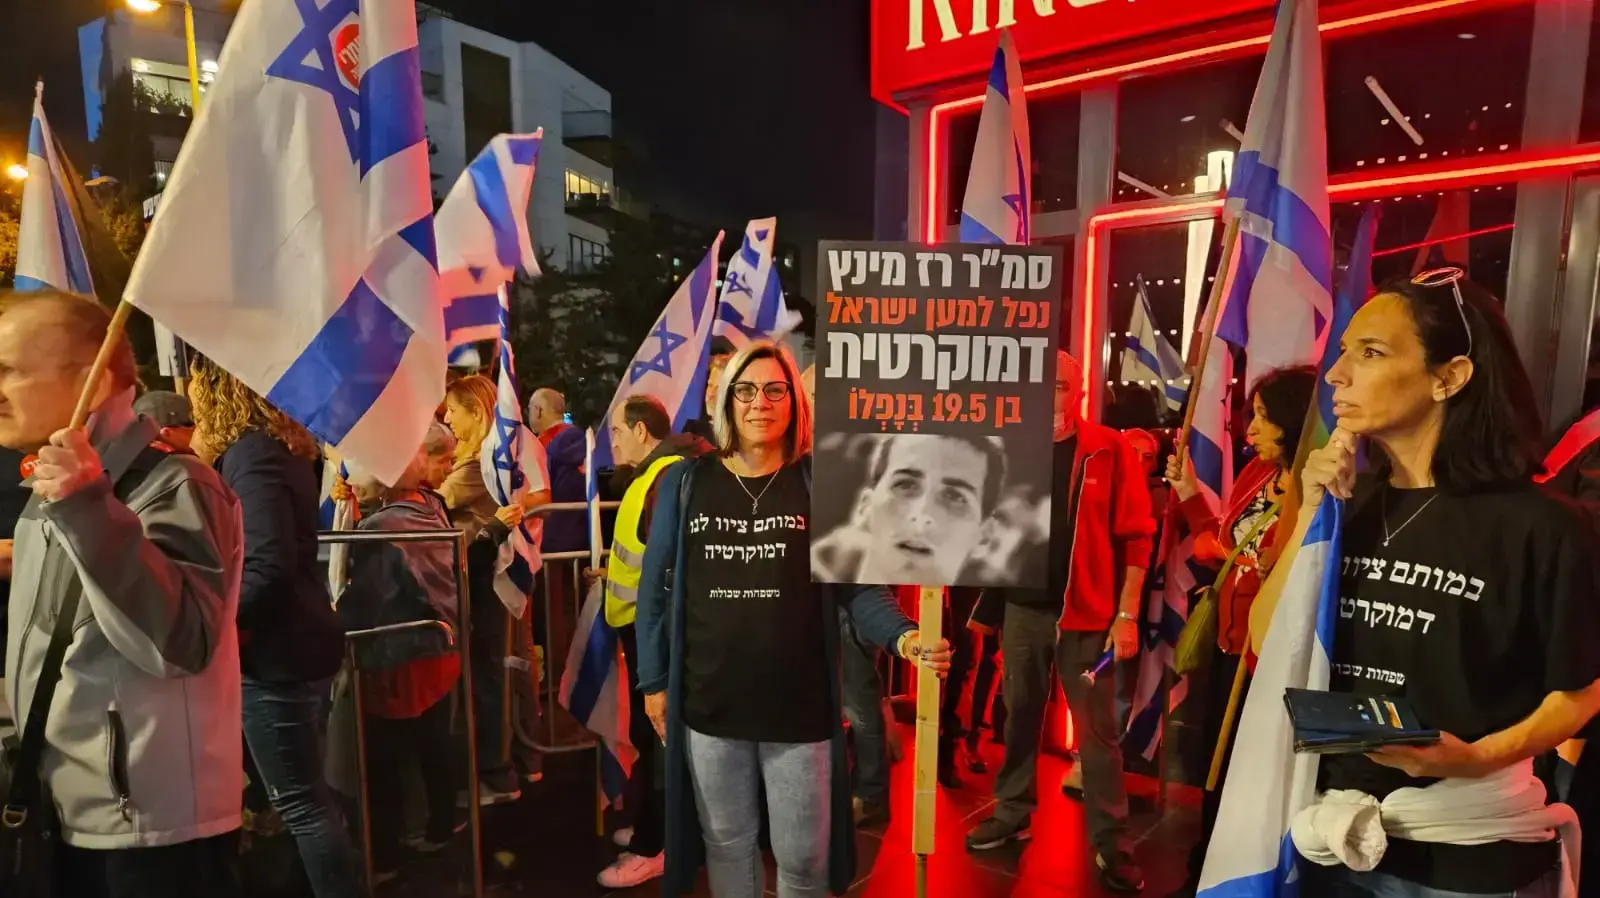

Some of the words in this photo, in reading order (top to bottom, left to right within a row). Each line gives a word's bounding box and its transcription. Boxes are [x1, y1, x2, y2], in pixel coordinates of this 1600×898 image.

[828, 250, 906, 291] מינץ
[916, 252, 953, 287] רז
[826, 291, 917, 325] ישראל
[926, 295, 995, 331] למען
[1002, 295, 1050, 329] נפל
[825, 331, 1049, 391] דמוקרטית
[931, 392, 987, 422] 19.5
[994, 396, 1022, 428] בן
[690, 513, 710, 534] לנו
[715, 516, 748, 534] ציוו
[753, 514, 806, 533] במותם
[704, 542, 787, 564] דמוקרטיה
[709, 586, 741, 599] שכולות
[742, 588, 781, 599] משפחות
[1389, 560, 1486, 602] במותם
[1339, 596, 1436, 634] דמוקרט
[1366, 665, 1406, 686] שפחות
